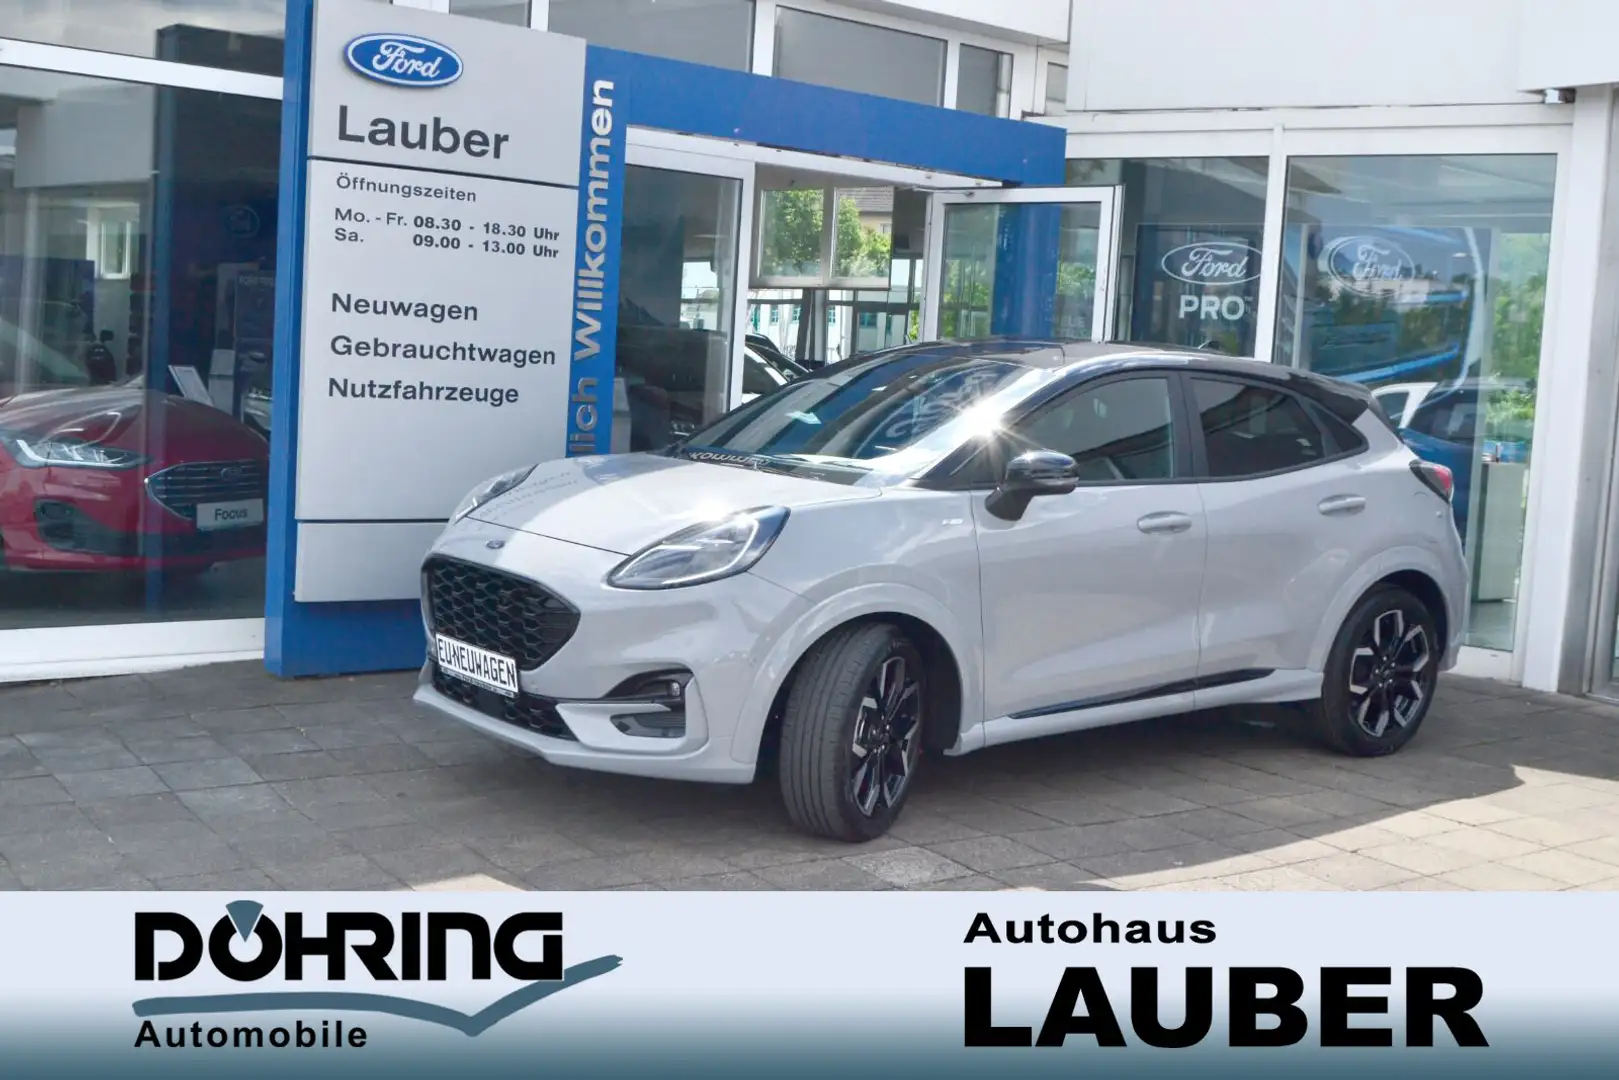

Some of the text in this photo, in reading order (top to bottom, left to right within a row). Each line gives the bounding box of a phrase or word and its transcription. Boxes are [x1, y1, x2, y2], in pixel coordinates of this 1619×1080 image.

[372, 41, 442, 79] Ford
[337, 104, 509, 159] Lauber
[336, 172, 477, 203] Öffnungszeiten
[334, 207, 370, 223] Mo.
[386, 212, 407, 226] Fr.
[413, 215, 462, 231] 08.30
[483, 221, 526, 238] 18.30
[533, 226, 560, 241] Uhr
[574, 79, 614, 362] Willkommen
[334, 227, 364, 242] Sa.
[412, 233, 461, 249] 09.00
[482, 239, 526, 255] 13.00
[532, 244, 559, 259] Uhr
[1181, 246, 1250, 278] Ford
[331, 292, 478, 323] Neuwagen
[330, 334, 556, 368] Gebrauchtwagen
[328, 377, 520, 407] Nutzfahrzeuge
[214, 508, 248, 521] Focus
